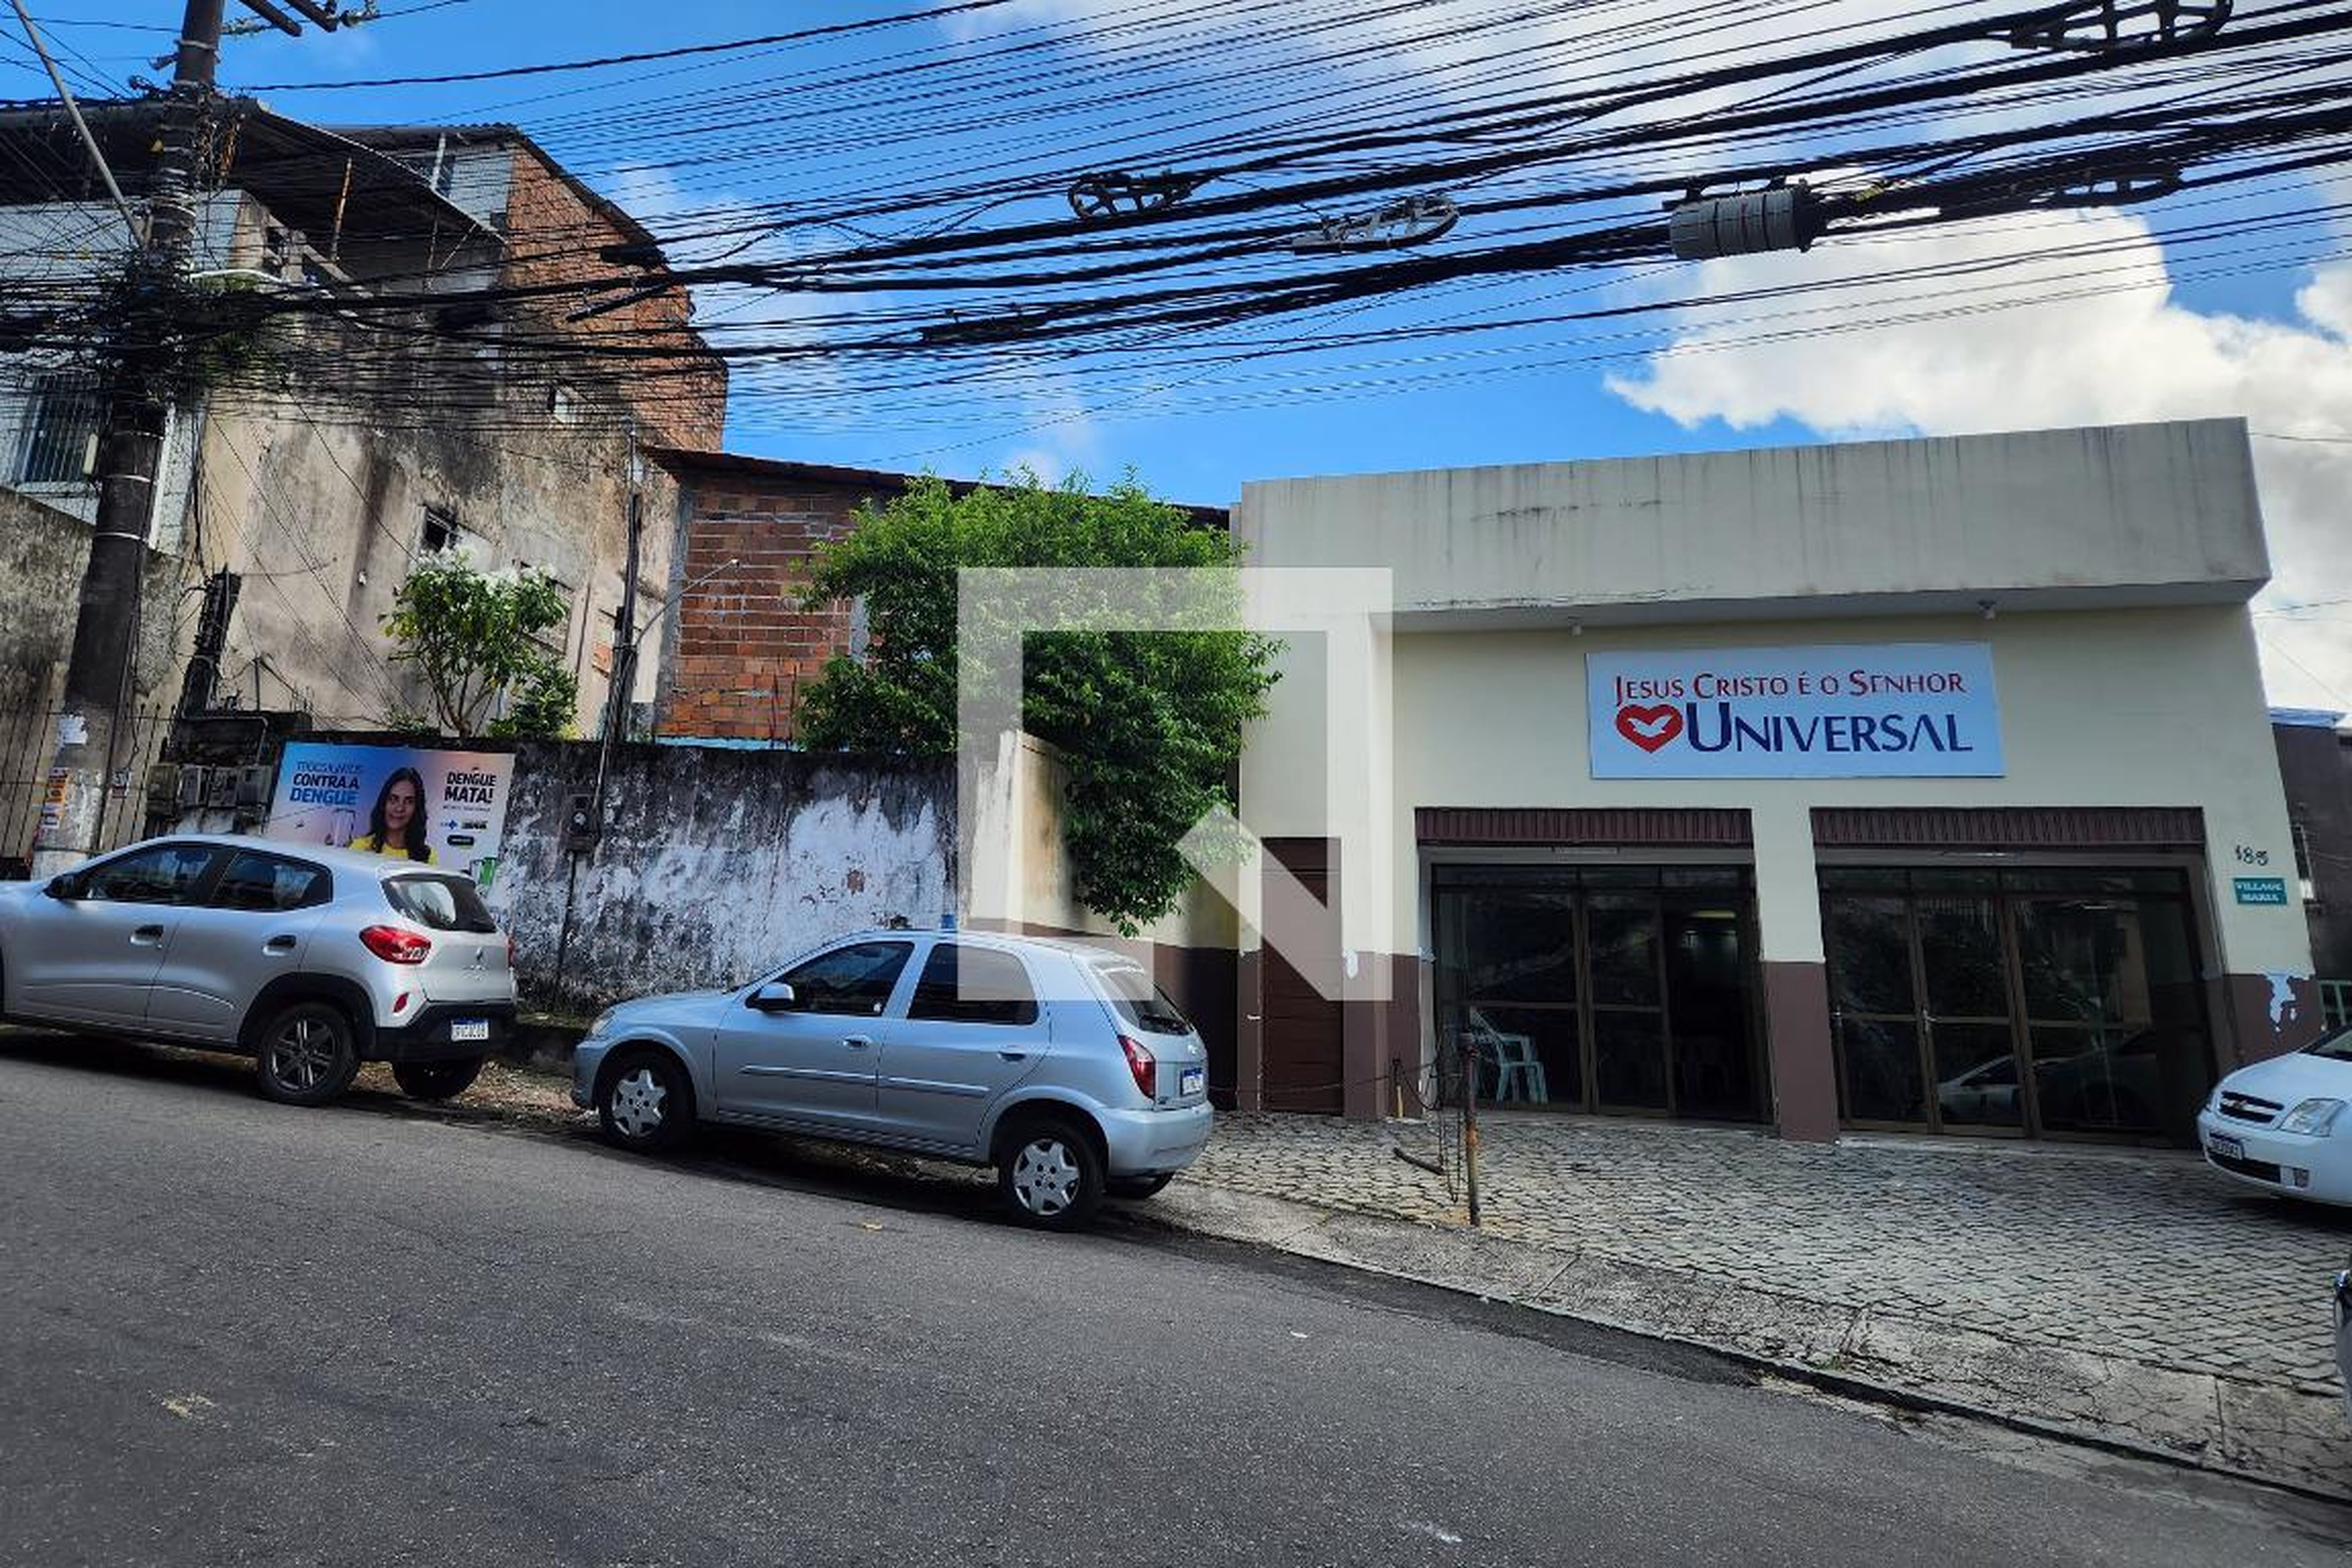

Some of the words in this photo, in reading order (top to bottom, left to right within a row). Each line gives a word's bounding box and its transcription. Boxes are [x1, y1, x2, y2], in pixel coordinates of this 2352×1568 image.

[1616, 676, 1684, 707] JESUS
[1693, 673, 1789, 699] CRISTO
[1798, 671, 1811, 695] É
[1820, 675, 1839, 695] O
[1849, 670, 1967, 696] SENHOR
[1686, 701, 1973, 752] UNIVERSAL
[293, 773, 347, 788] CONTRA
[348, 775, 360, 790] A
[447, 771, 497, 786] DENGUE
[290, 787, 360, 805] DENGUE
[444, 786, 494, 804] MATA!
